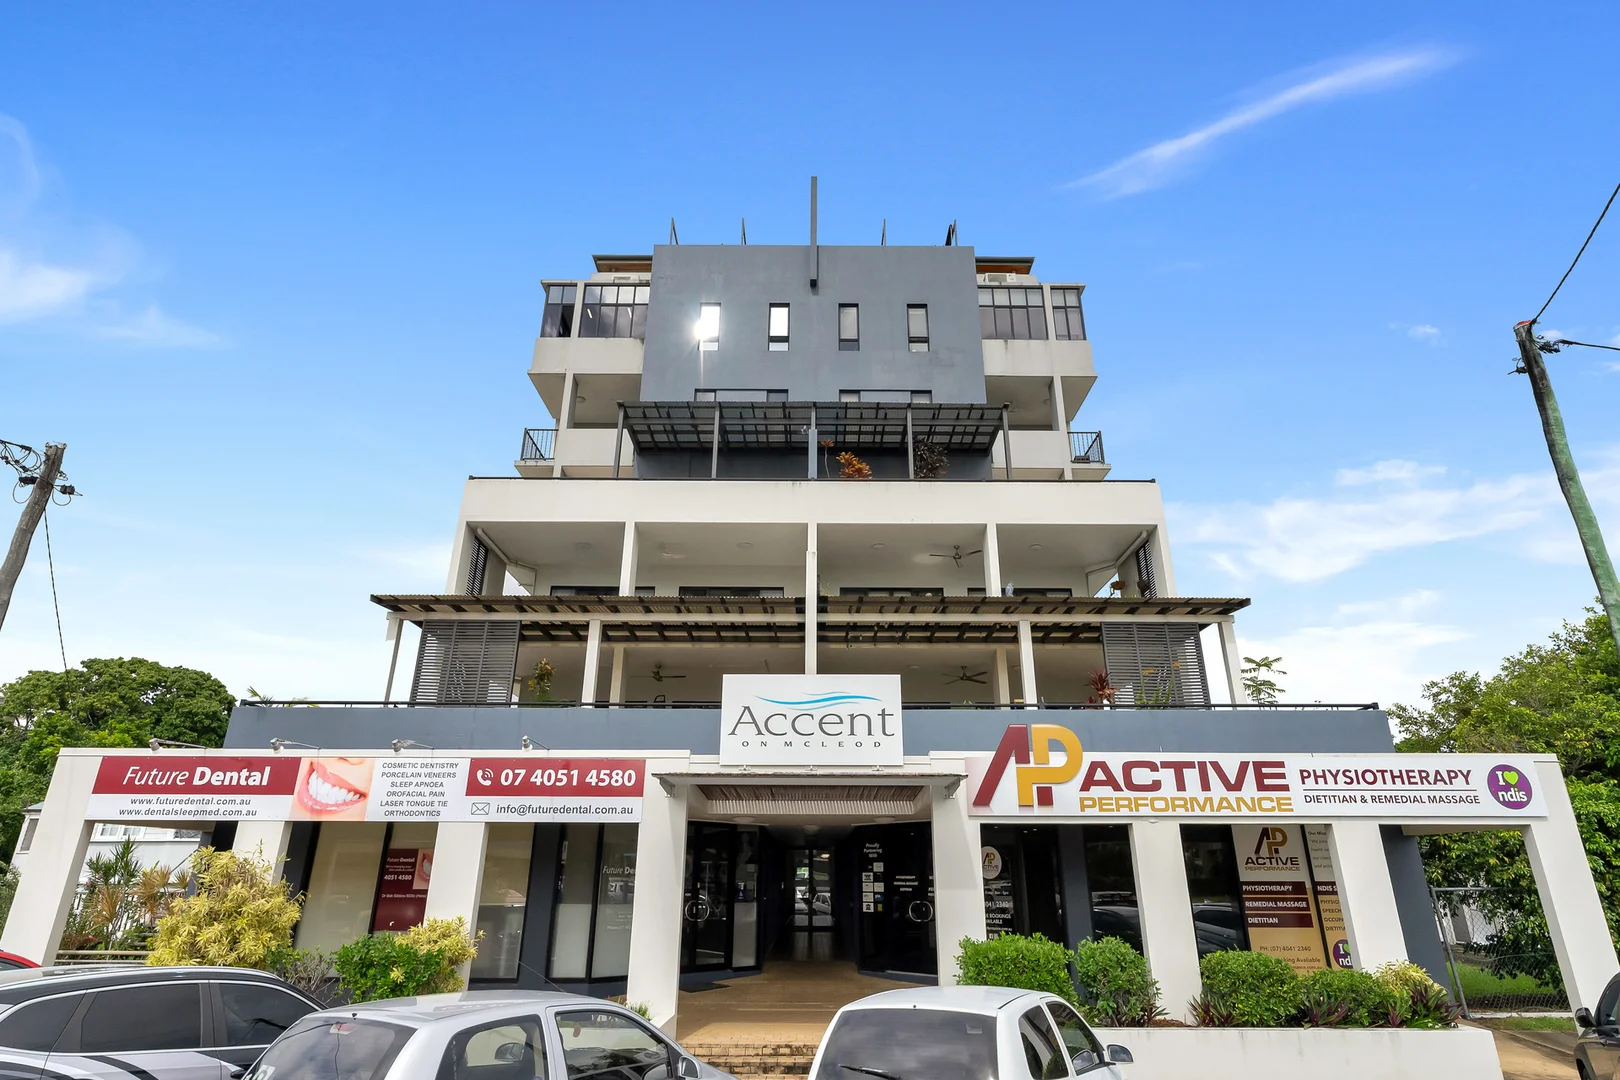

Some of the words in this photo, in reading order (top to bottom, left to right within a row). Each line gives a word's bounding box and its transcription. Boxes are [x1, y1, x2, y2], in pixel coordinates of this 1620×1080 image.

[727, 705, 895, 737] Accent
[741, 740, 767, 748] ON
[784, 740, 881, 748] MCLEOD
[972, 723, 1083, 806] AP
[122, 766, 189, 786] Future
[192, 766, 271, 786] Dental
[500, 769, 526, 786] 07
[530, 769, 578, 786] 4051
[585, 769, 637, 787] 4580
[1079, 760, 1291, 793] ACTIVE
[1299, 768, 1472, 786] PHYSIOTHERAPY
[1495, 770, 1505, 786] I
[130, 796, 251, 806] www.futuredental.com.au
[1304, 794, 1357, 804] DIETITIAN
[1360, 795, 1369, 804] &
[1371, 795, 1426, 805] REMEDIAL
[1427, 795, 1481, 805] MASSAGE
[1498, 788, 1528, 802] ndis
[496, 804, 634, 817] info@futuredental.com.au
[1079, 796, 1294, 813] PERFORMANCE
[119, 807, 257, 818] www.dentalsleepmed.com.au
[1244, 856, 1300, 866] ACTIVE
[603, 866, 624, 874] Future
[624, 866, 637, 875] De
